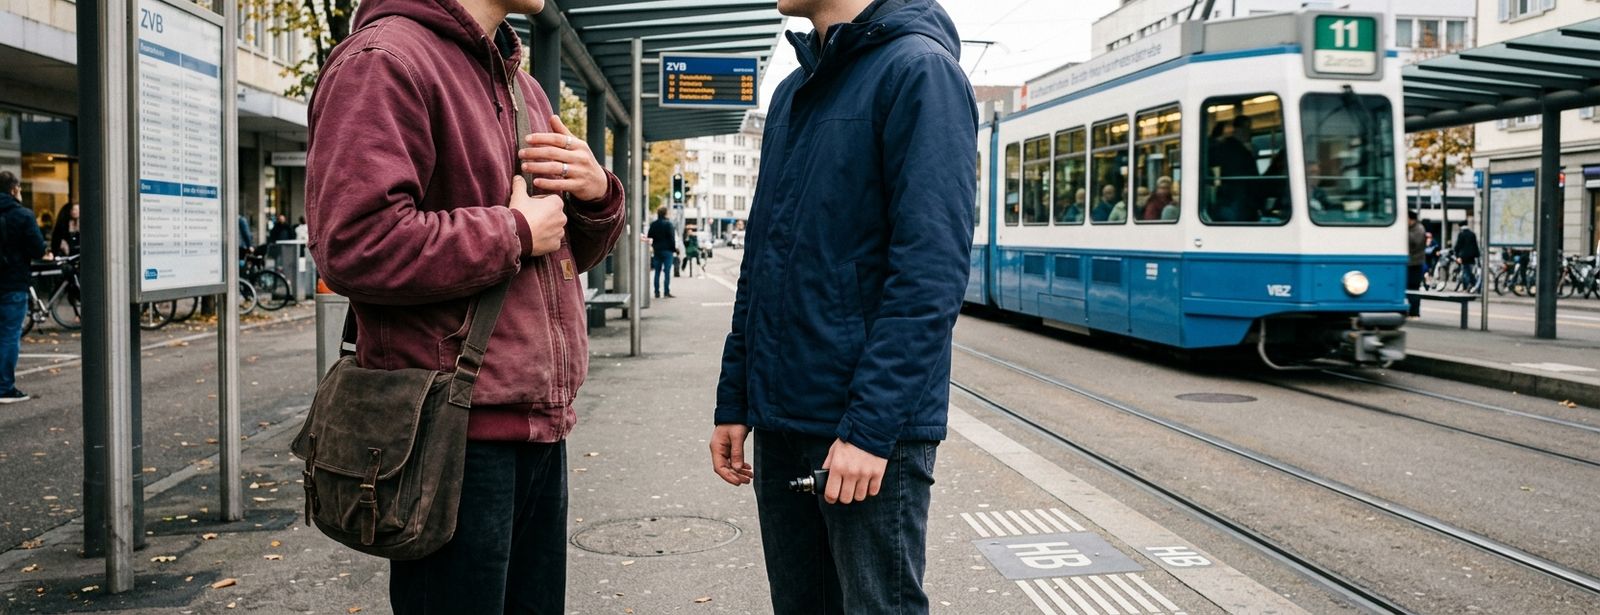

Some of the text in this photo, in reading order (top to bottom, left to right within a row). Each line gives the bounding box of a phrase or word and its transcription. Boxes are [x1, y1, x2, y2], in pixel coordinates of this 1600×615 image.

[140, 8, 164, 34] ZVB
[1329, 19, 1359, 48] 11
[666, 62, 687, 71] ZVB
[1007, 541, 1093, 570] HB
[1145, 546, 1212, 568] HB
